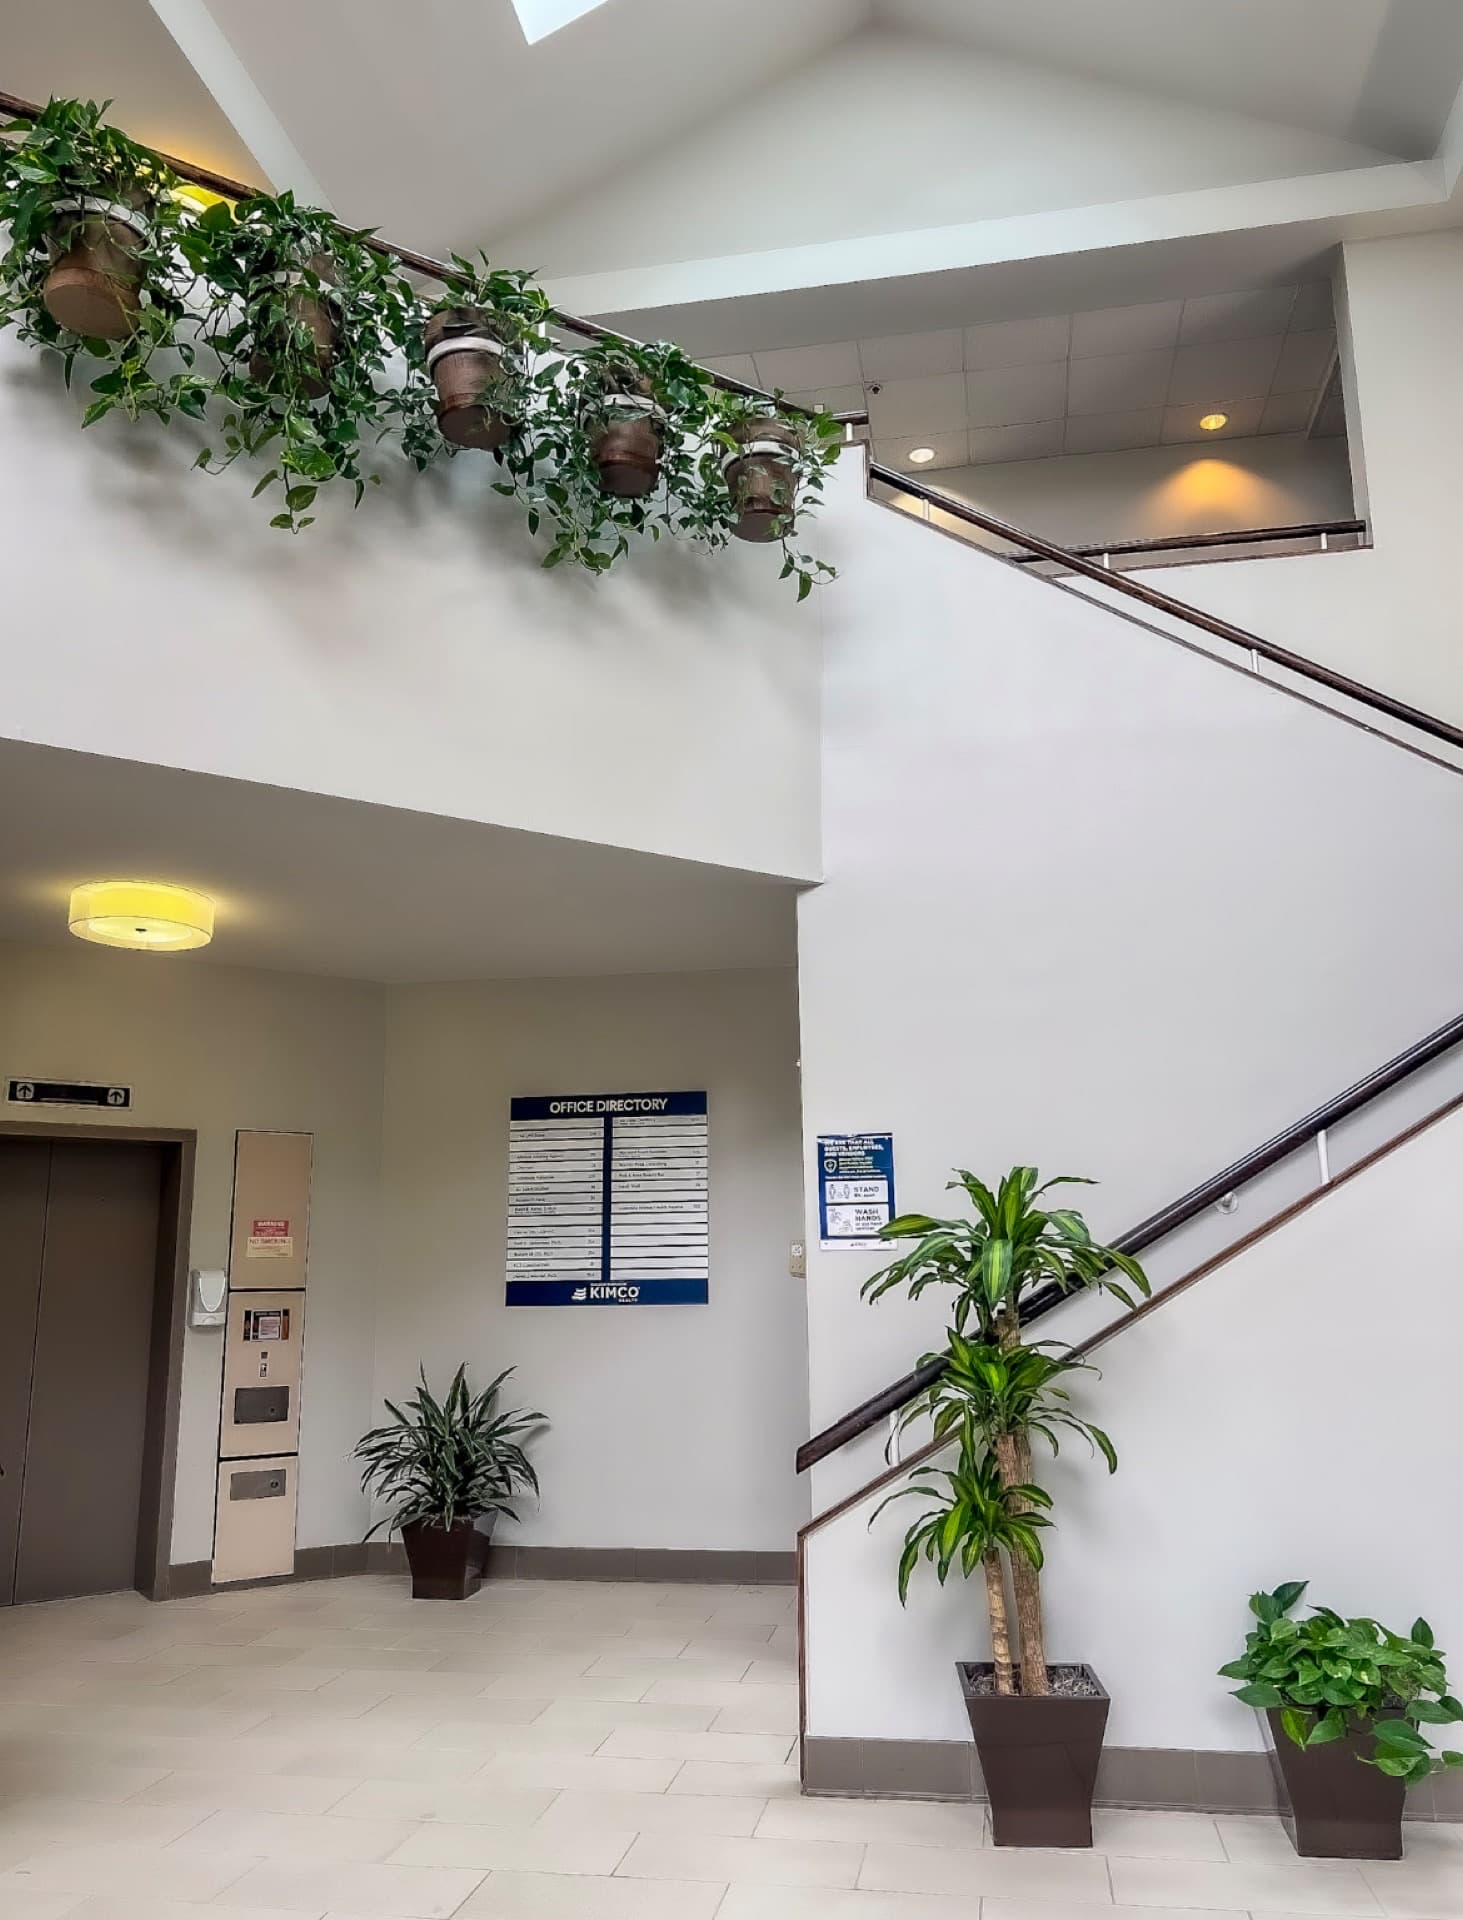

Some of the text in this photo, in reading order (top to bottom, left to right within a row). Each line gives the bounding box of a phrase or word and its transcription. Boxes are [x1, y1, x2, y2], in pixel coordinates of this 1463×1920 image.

[549, 1098, 668, 1114] OFFICE DIRECTORY
[590, 1286, 639, 1299] KIMCO
